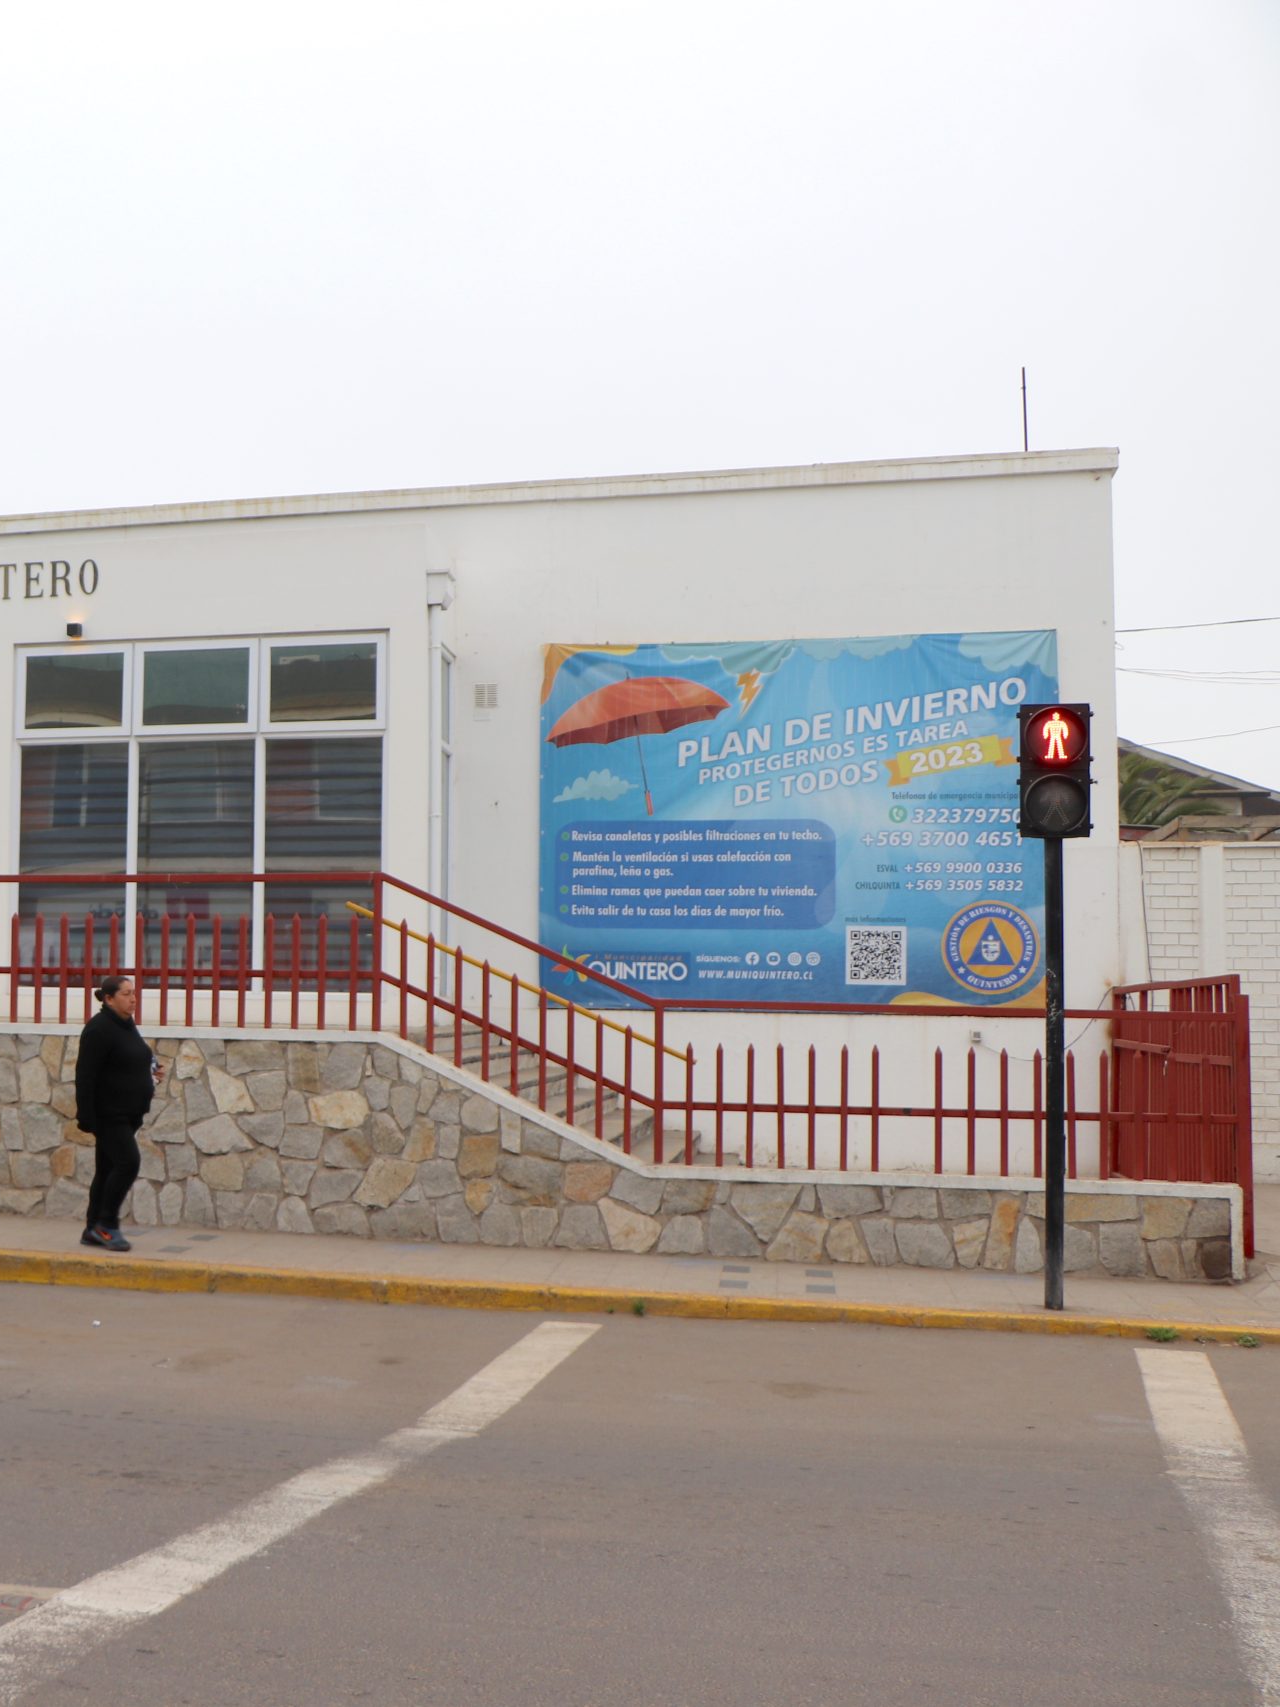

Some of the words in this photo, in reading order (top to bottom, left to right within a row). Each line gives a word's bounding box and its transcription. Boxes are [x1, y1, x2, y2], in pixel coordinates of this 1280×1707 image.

[678, 725, 771, 767] PLAN
[785, 713, 832, 746] DE
[845, 677, 1027, 735] INVIERNO
[699, 741, 855, 784] PROTEGERNOS
[863, 734, 888, 753] ES
[896, 720, 968, 749] TAREA
[909, 743, 983, 773] 2023
[734, 782, 770, 807] DE
[780, 760, 879, 797] TODOS
[985, 792, 1018, 801] municipa
[572, 831, 603, 841] Revisa
[605, 831, 651, 841] canaletas
[655, 833, 661, 843] y
[663, 830, 702, 843] posibles
[705, 829, 761, 841] filtraciones
[763, 832, 776, 840] en
[779, 831, 789, 840] tu
[792, 829, 822, 840] techo.
[862, 831, 913, 847] +569
[918, 831, 969, 847] 3700
[975, 831, 1023, 847] 4651
[573, 851, 610, 862] Mantén
[613, 851, 622, 862] la
[625, 851, 678, 862] ventilación
[681, 852, 689, 862] si
[692, 854, 714, 862] usas
[716, 851, 771, 862] calefacción
[774, 853, 791, 861] con
[573, 865, 617, 877] parafina,
[620, 865, 641, 876] leña
[644, 868, 650, 876] o
[653, 868, 674, 879] gas.
[877, 864, 898, 873] ESVAL
[904, 862, 941, 874] +569
[946, 862, 981, 873] 9900
[986, 862, 1022, 873] 0336
[572, 885, 607, 896] Elimina
[611, 887, 641, 896] ramas
[643, 887, 662, 898] que
[665, 885, 702, 898] puedan
[704, 887, 725, 896] caer
[728, 885, 755, 896] sobre
[758, 886, 768, 896] tu
[771, 885, 818, 896] vivienda.
[855, 881, 900, 890] CHILQUINTA
[905, 879, 942, 891] +569
[946, 879, 983, 891] 3505
[987, 880, 1023, 891] 5832
[572, 905, 595, 916] Evita
[597, 905, 619, 916] salir
[622, 905, 634, 916] de
[637, 906, 647, 916] tu
[649, 907, 672, 916] casa
[674, 905, 688, 916] los
[690, 905, 711, 916] días
[714, 905, 727, 916] de
[729, 907, 761, 919] mayor
[763, 905, 784, 916] frío.
[958, 915, 969, 927] DE
[969, 906, 1008, 918] RIESGOS
[1008, 910, 1016, 919] Y
[1014, 915, 1034, 962] DESASTRES
[588, 960, 688, 981] QUINTERO
[698, 969, 813, 980] WWW.MUNIQUINTERO.CL
[967, 973, 1018, 988] QUINTERO
